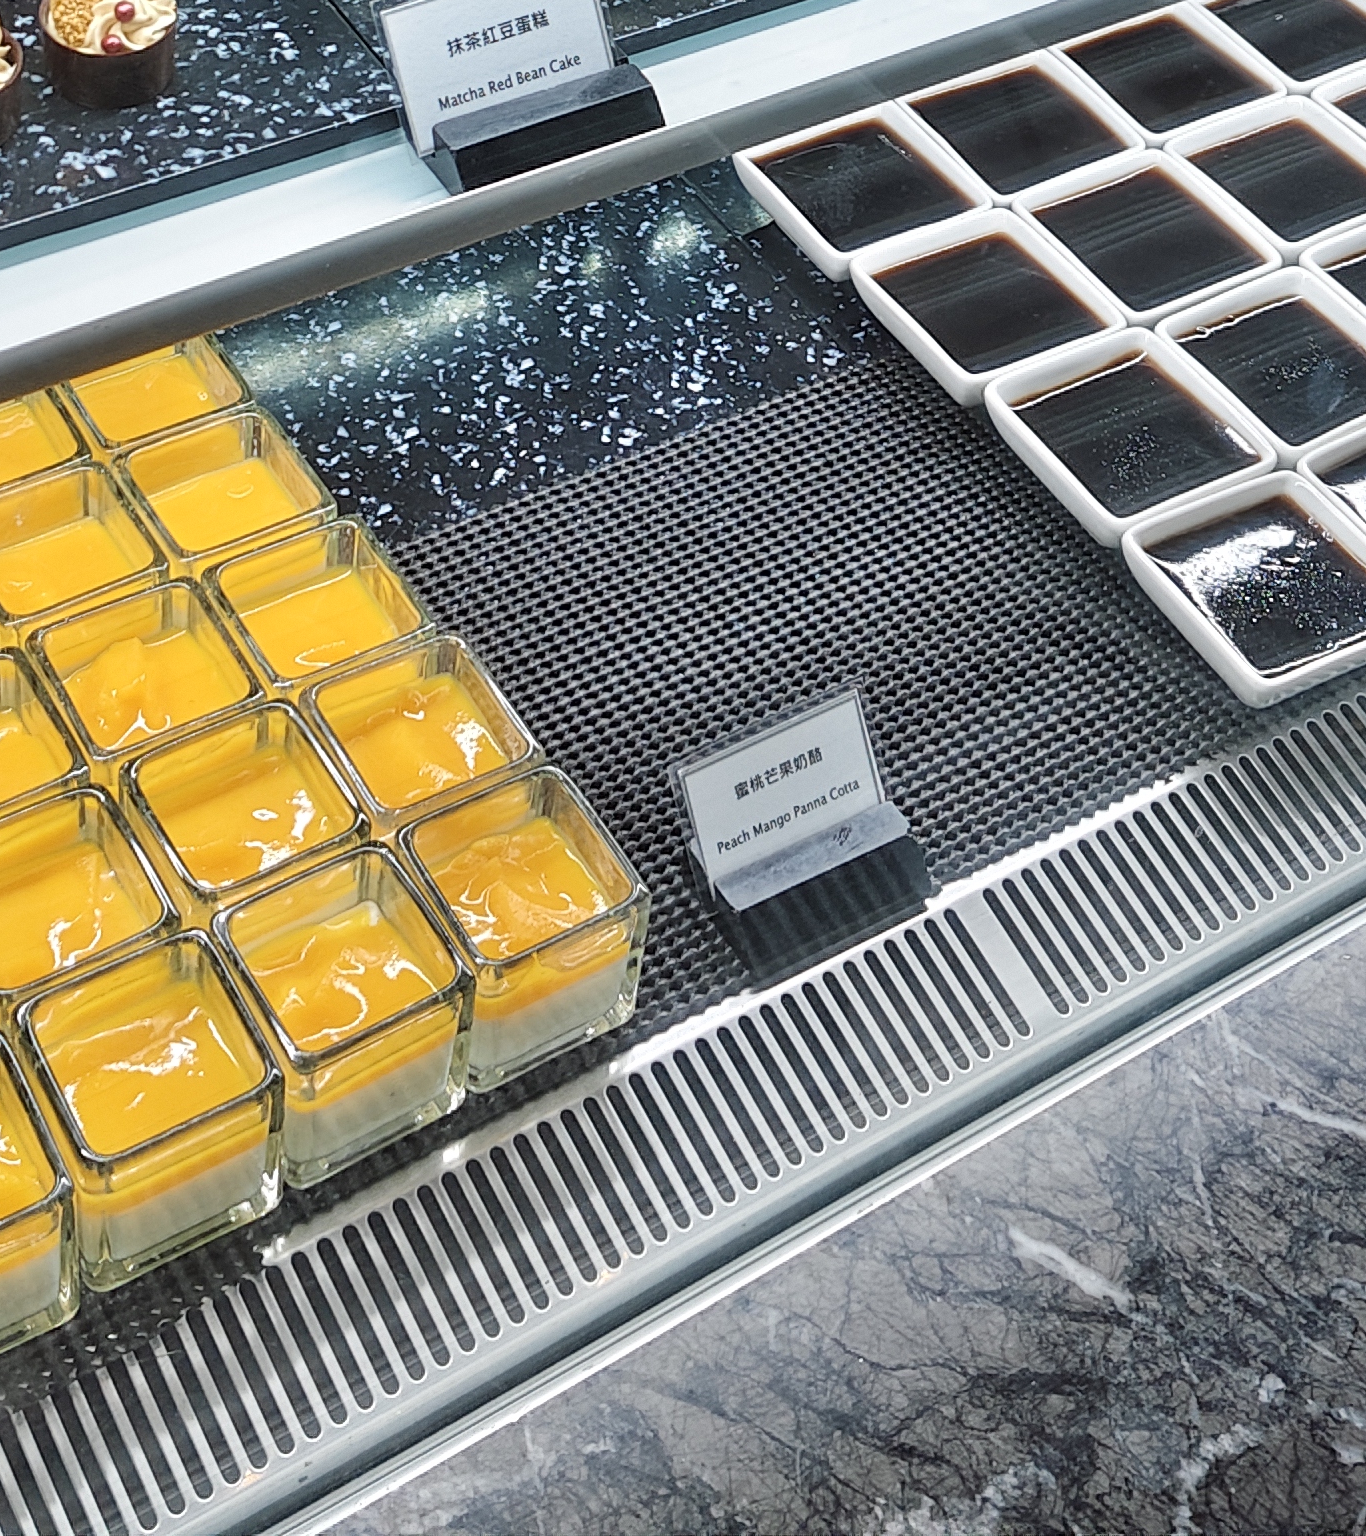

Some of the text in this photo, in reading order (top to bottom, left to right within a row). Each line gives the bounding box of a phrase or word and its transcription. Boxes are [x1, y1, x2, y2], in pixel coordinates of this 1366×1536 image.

[445, 8, 551, 58] 抹茶紅豆蛋糕
[437, 53, 582, 112] Matcha Red Bean Cake
[733, 747, 823, 801] 蜜桃芒果奶酪
[716, 779, 861, 855] Peach Mango Panna Cotta
